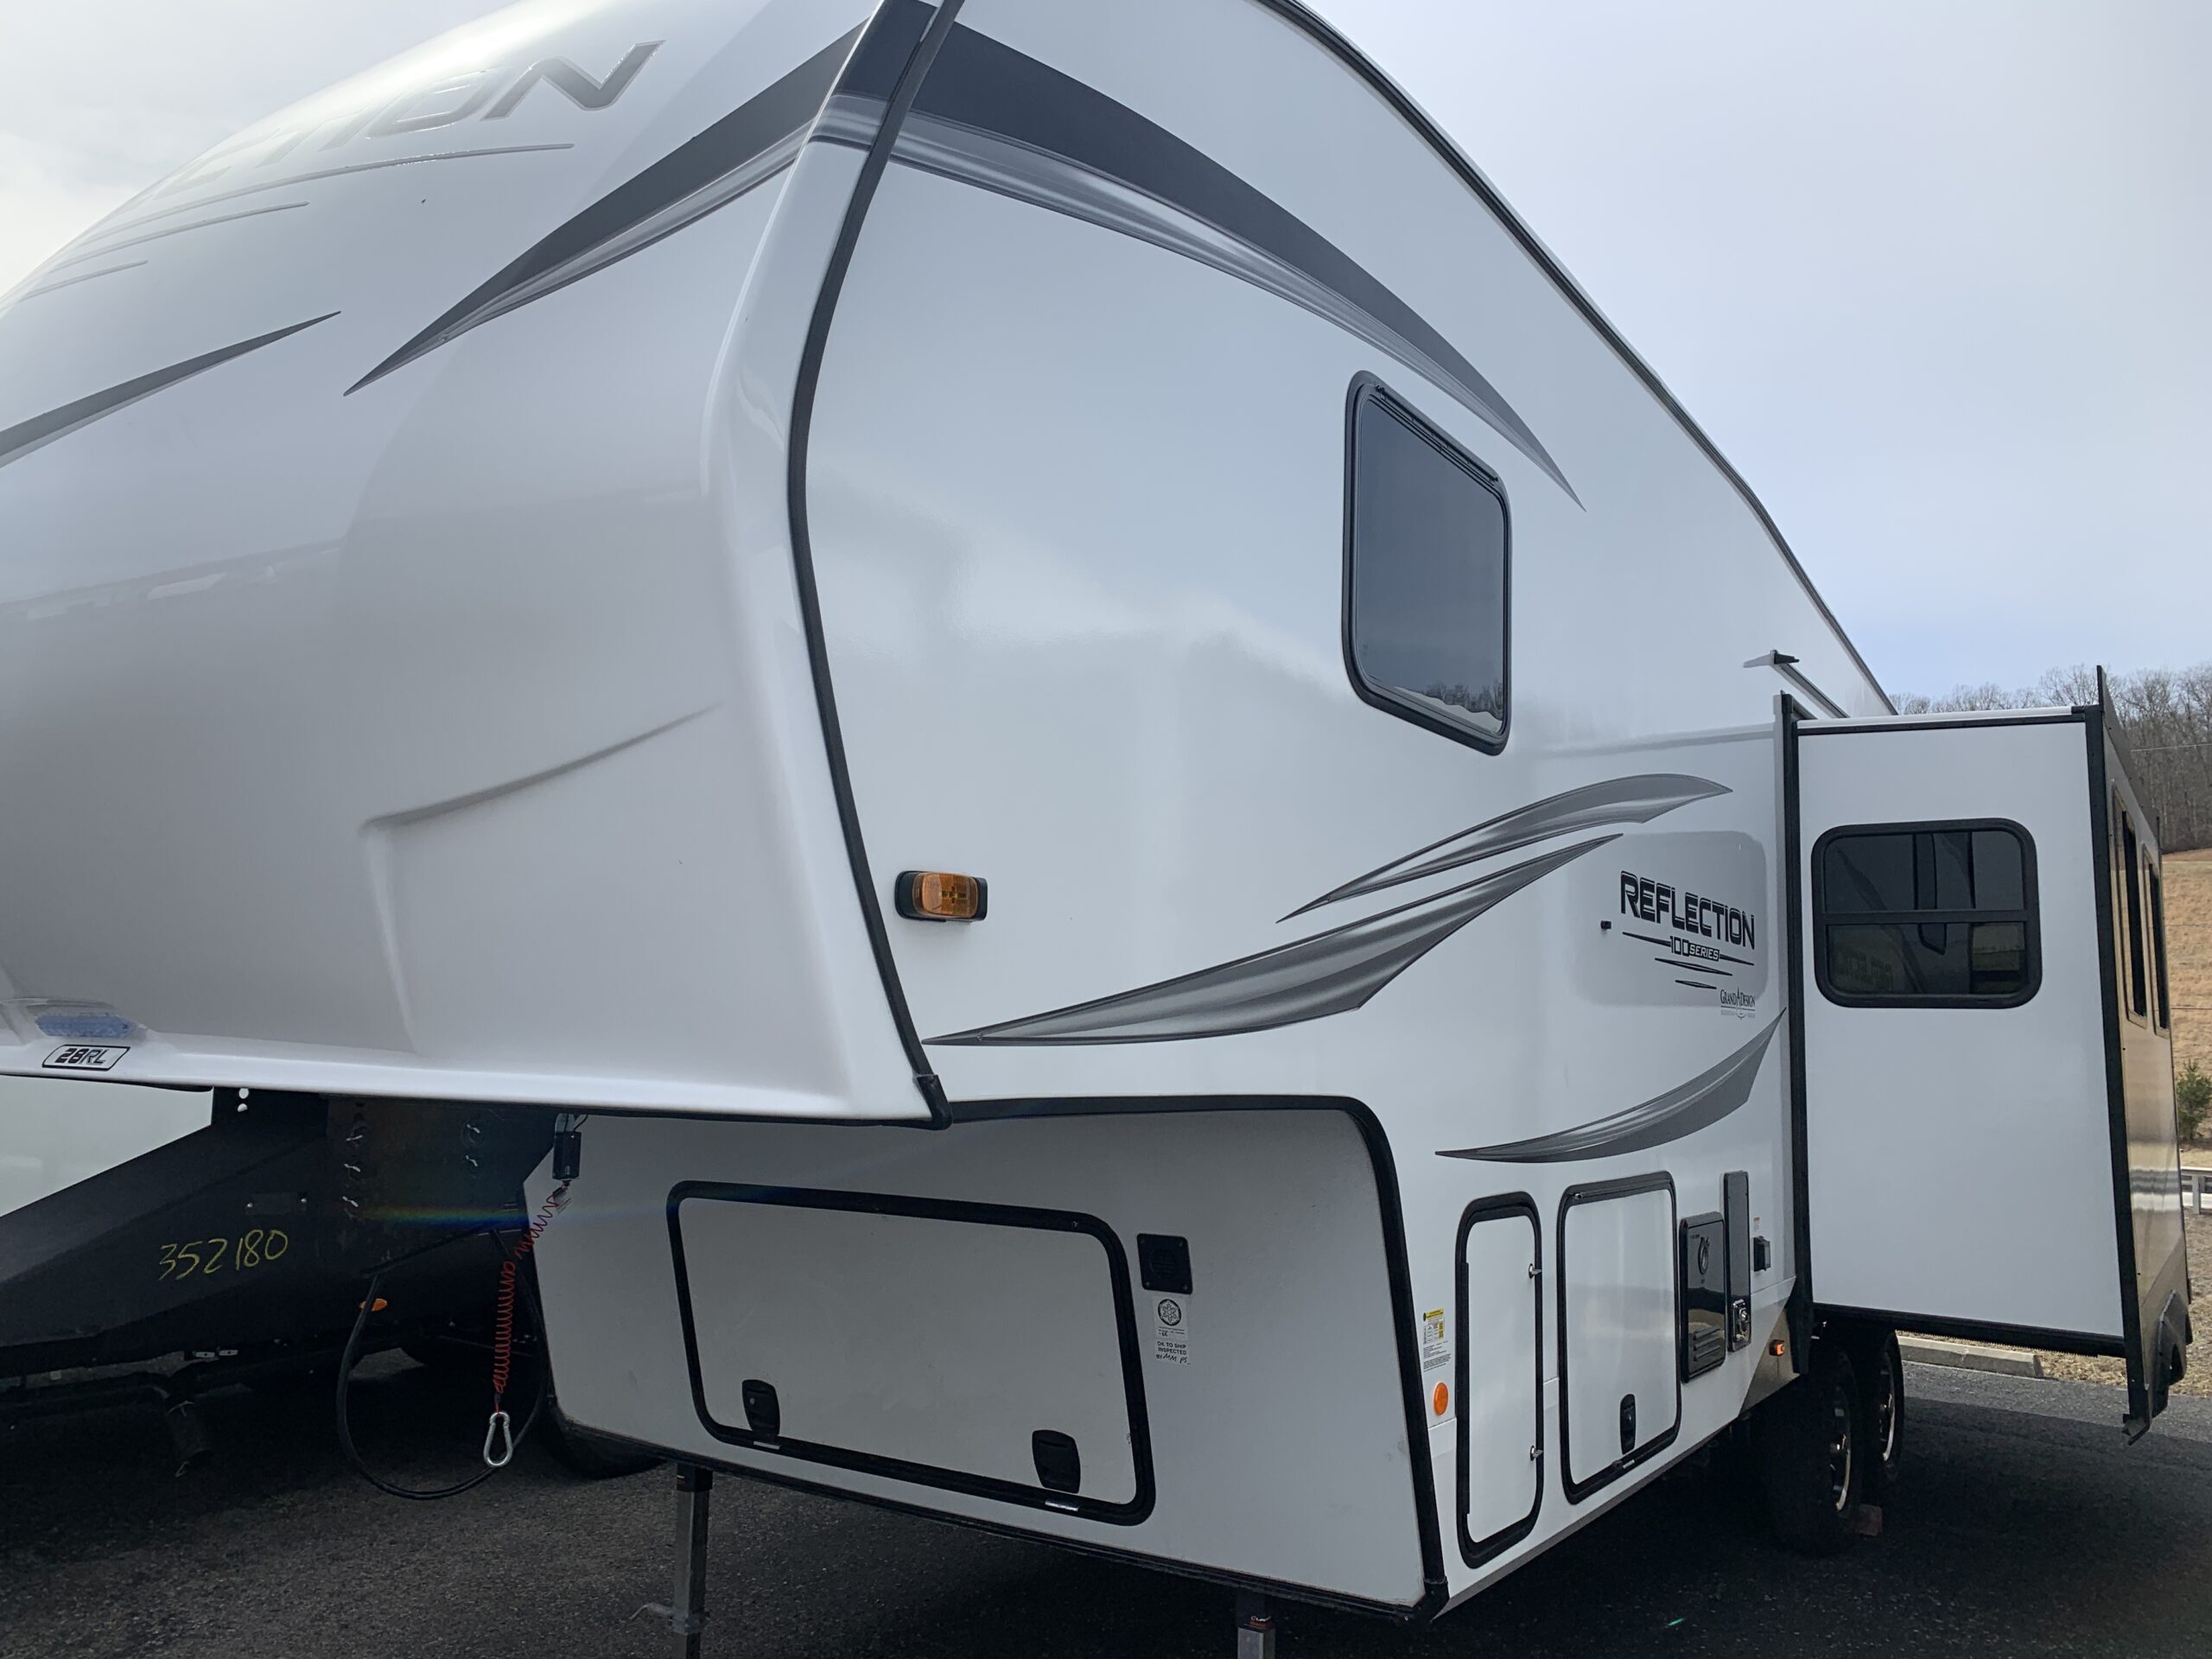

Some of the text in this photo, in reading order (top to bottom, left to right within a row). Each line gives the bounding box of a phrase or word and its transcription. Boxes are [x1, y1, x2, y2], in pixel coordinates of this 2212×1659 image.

[1620, 870, 1755, 950] REFLECTION
[1689, 943, 1719, 961] SERIES
[54, 1047, 109, 1065] 28RL
[159, 1230, 289, 1281] 352180
[1158, 1347, 1187, 1356] INSPECTED
